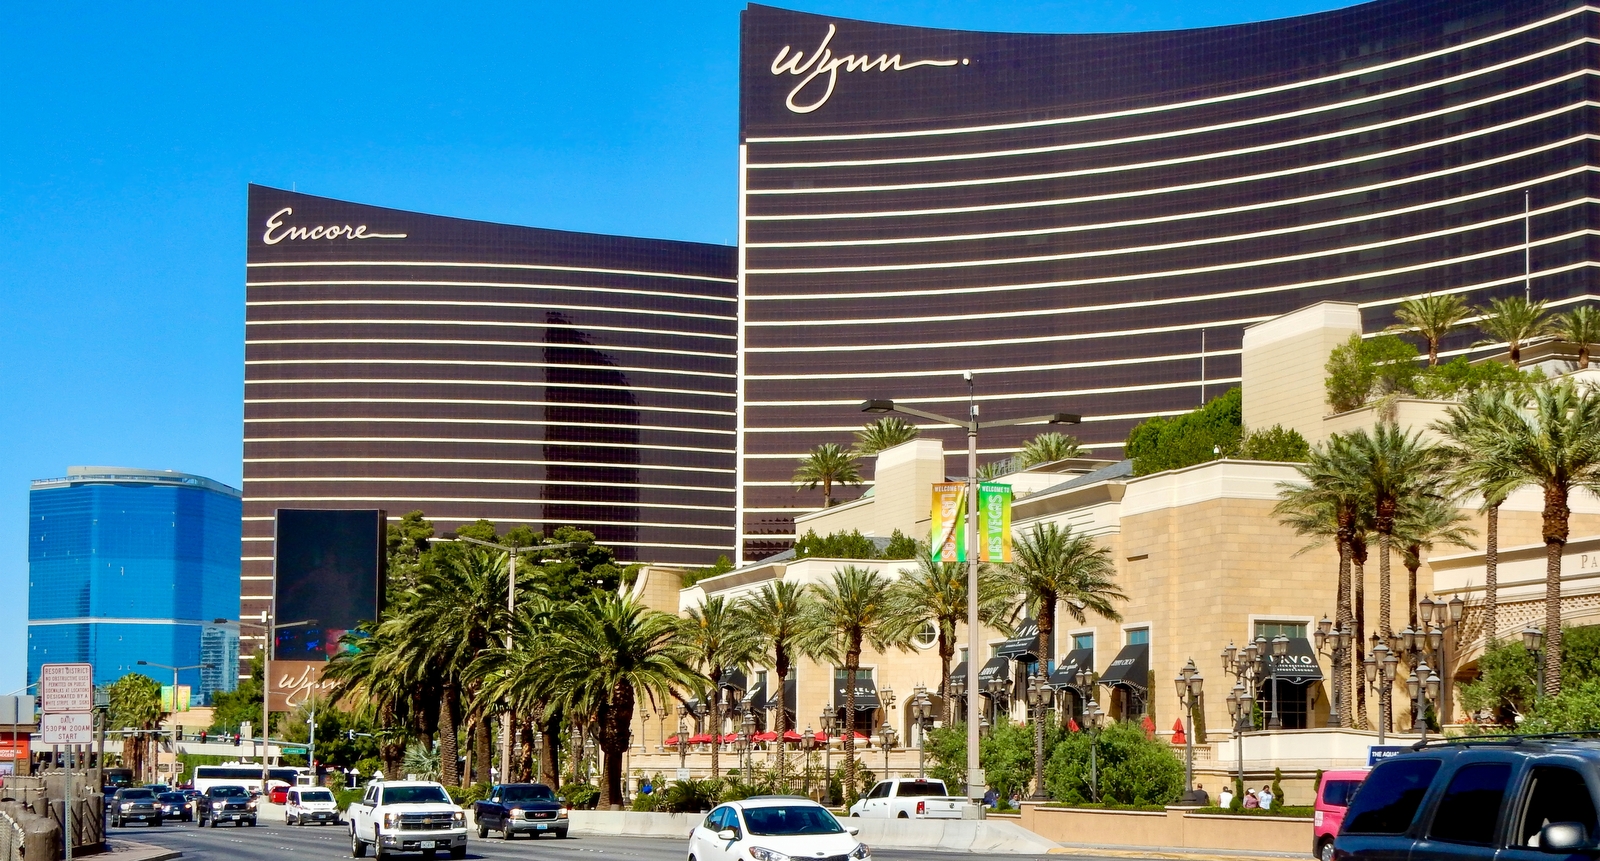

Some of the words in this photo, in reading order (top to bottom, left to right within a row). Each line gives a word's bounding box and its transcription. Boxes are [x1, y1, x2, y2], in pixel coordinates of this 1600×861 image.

[263, 207, 407, 245] Encore
[942, 493, 956, 518] LAS
[988, 494, 1003, 535] VEGAS
[989, 536, 1003, 560] LAS
